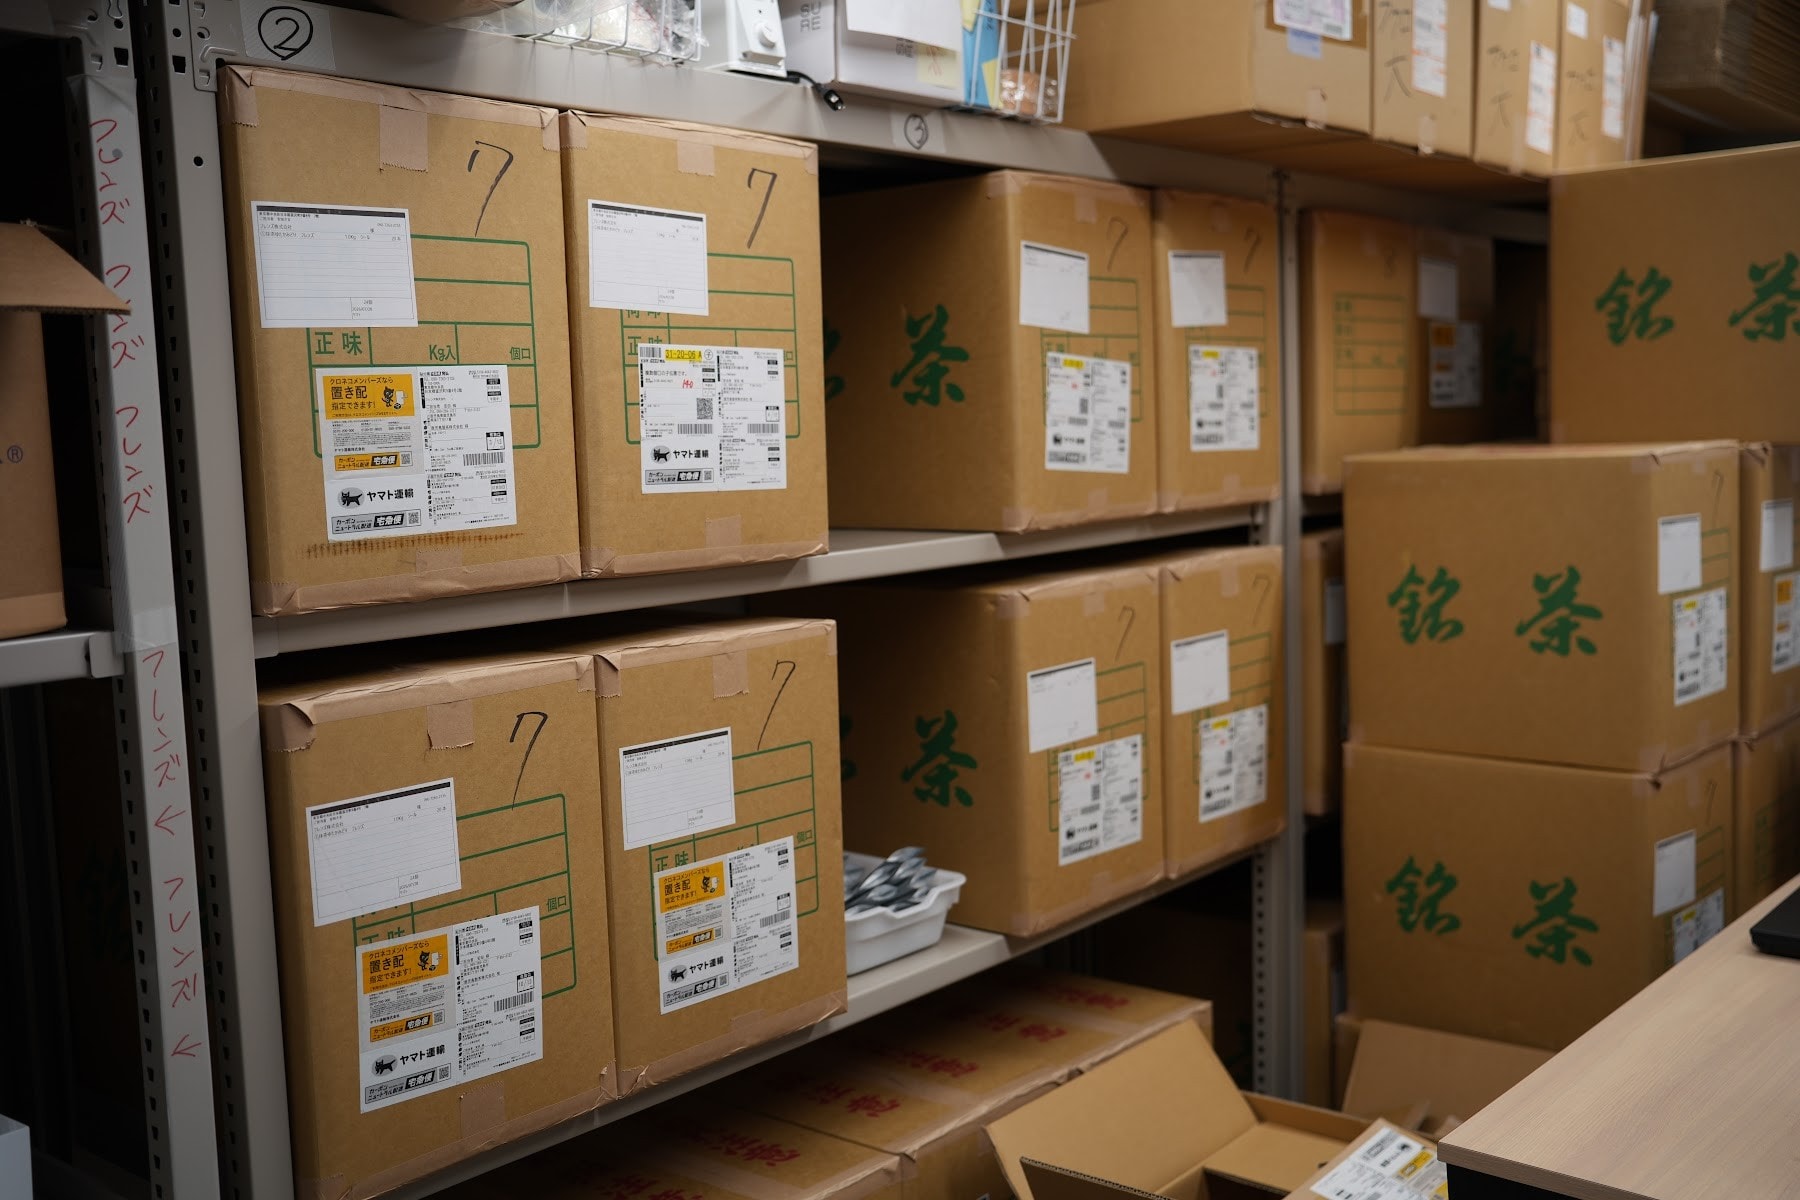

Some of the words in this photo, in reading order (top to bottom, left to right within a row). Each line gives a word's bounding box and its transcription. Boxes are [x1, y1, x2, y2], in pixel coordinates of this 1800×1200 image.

[90, 119, 130, 224] フレンズ
[106, 264, 144, 369] フンズ
[315, 331, 363, 356] 正味
[509, 346, 532, 361] 個口
[331, 385, 368, 400] 置き配
[115, 405, 154, 523] フレンズ
[673, 449, 709, 459] ヤマト運輸
[367, 488, 414, 502] ヤマト運輸
[1387, 564, 1603, 657] 銘茶
[665, 878, 691, 896] 置き配
[1386, 855, 1598, 967] 銘茶
[163, 877, 198, 1008] フレンズ
[369, 954, 405, 974] 置き配
[689, 956, 724, 974] ヤマト運輸
[400, 1044, 446, 1066] ヤマト運輸
